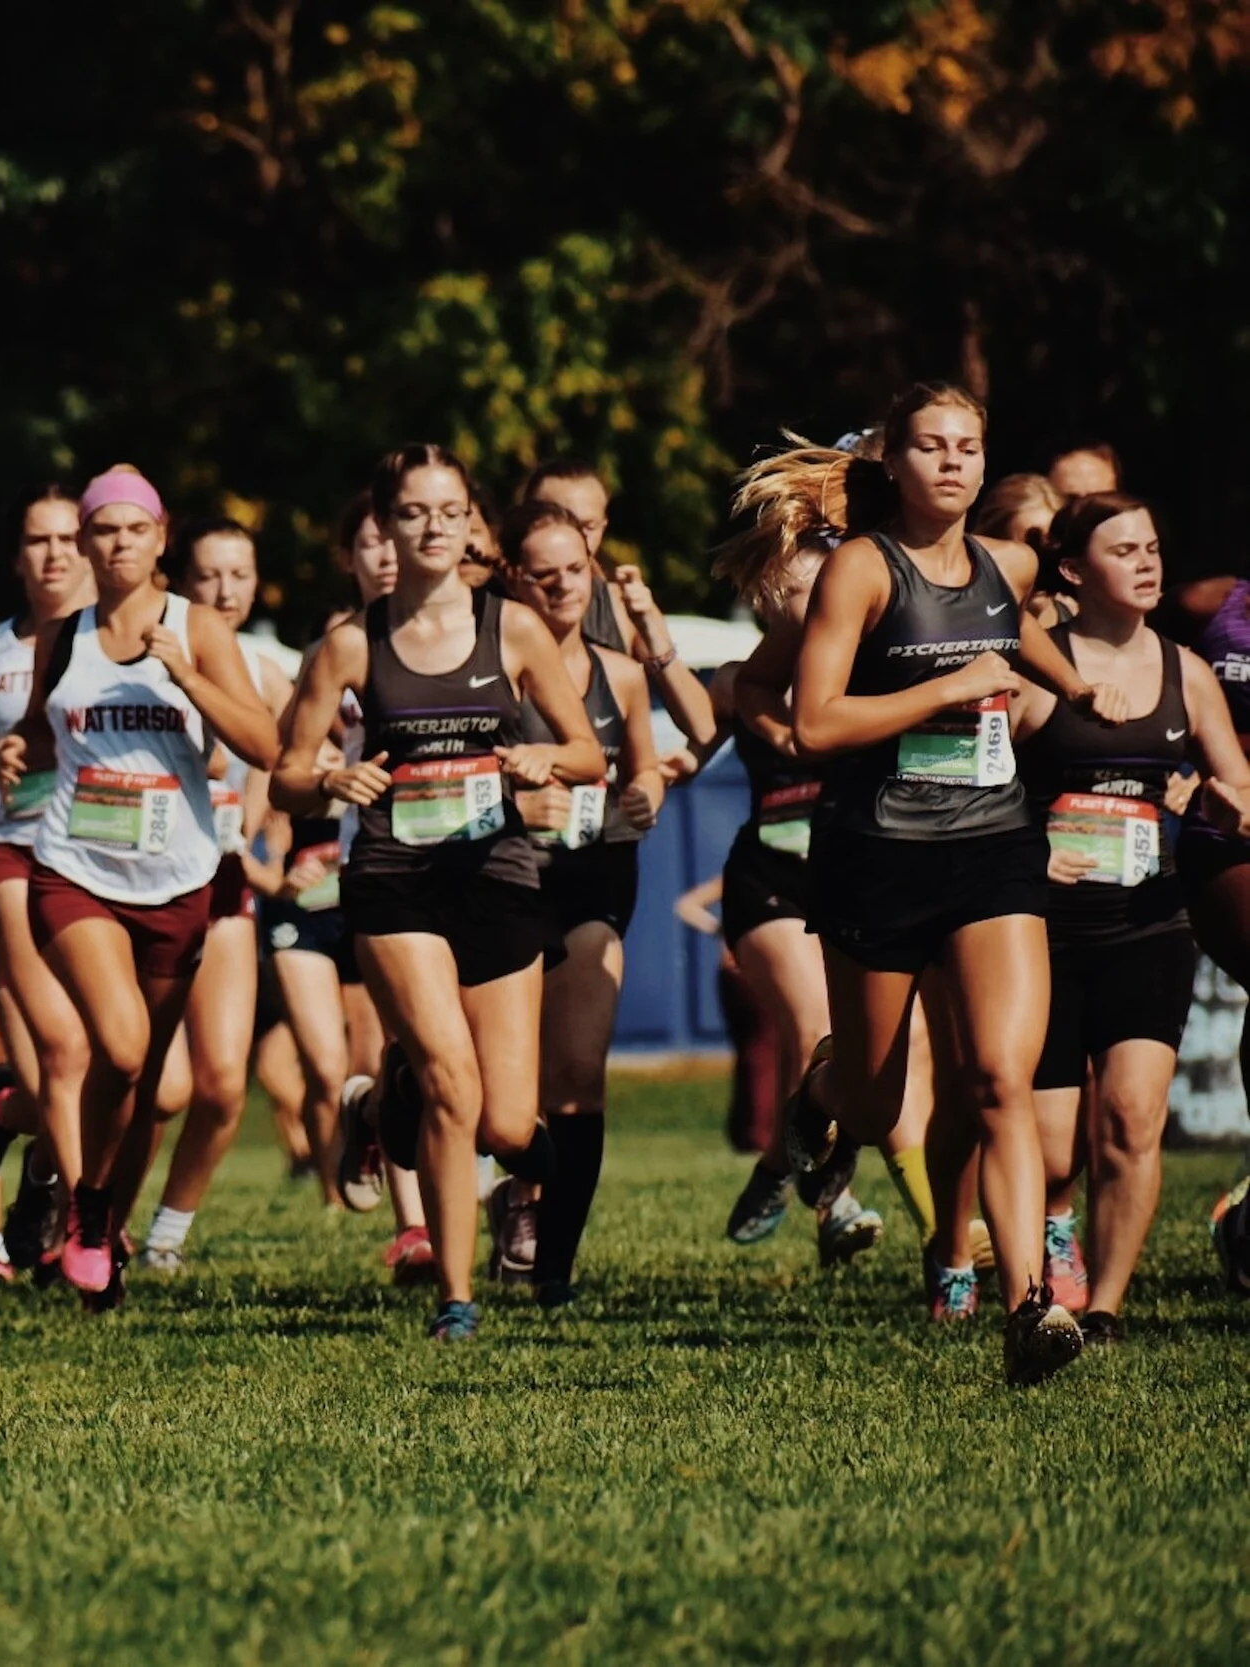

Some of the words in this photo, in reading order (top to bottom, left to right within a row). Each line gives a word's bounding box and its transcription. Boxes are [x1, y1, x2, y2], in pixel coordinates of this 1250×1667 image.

[887, 638, 1020, 657] PICKERINGTO
[934, 654, 976, 668] NOR
[986, 717, 1006, 775] 2469
[150, 794, 170, 843] 2846
[1133, 823, 1150, 877] 2452
